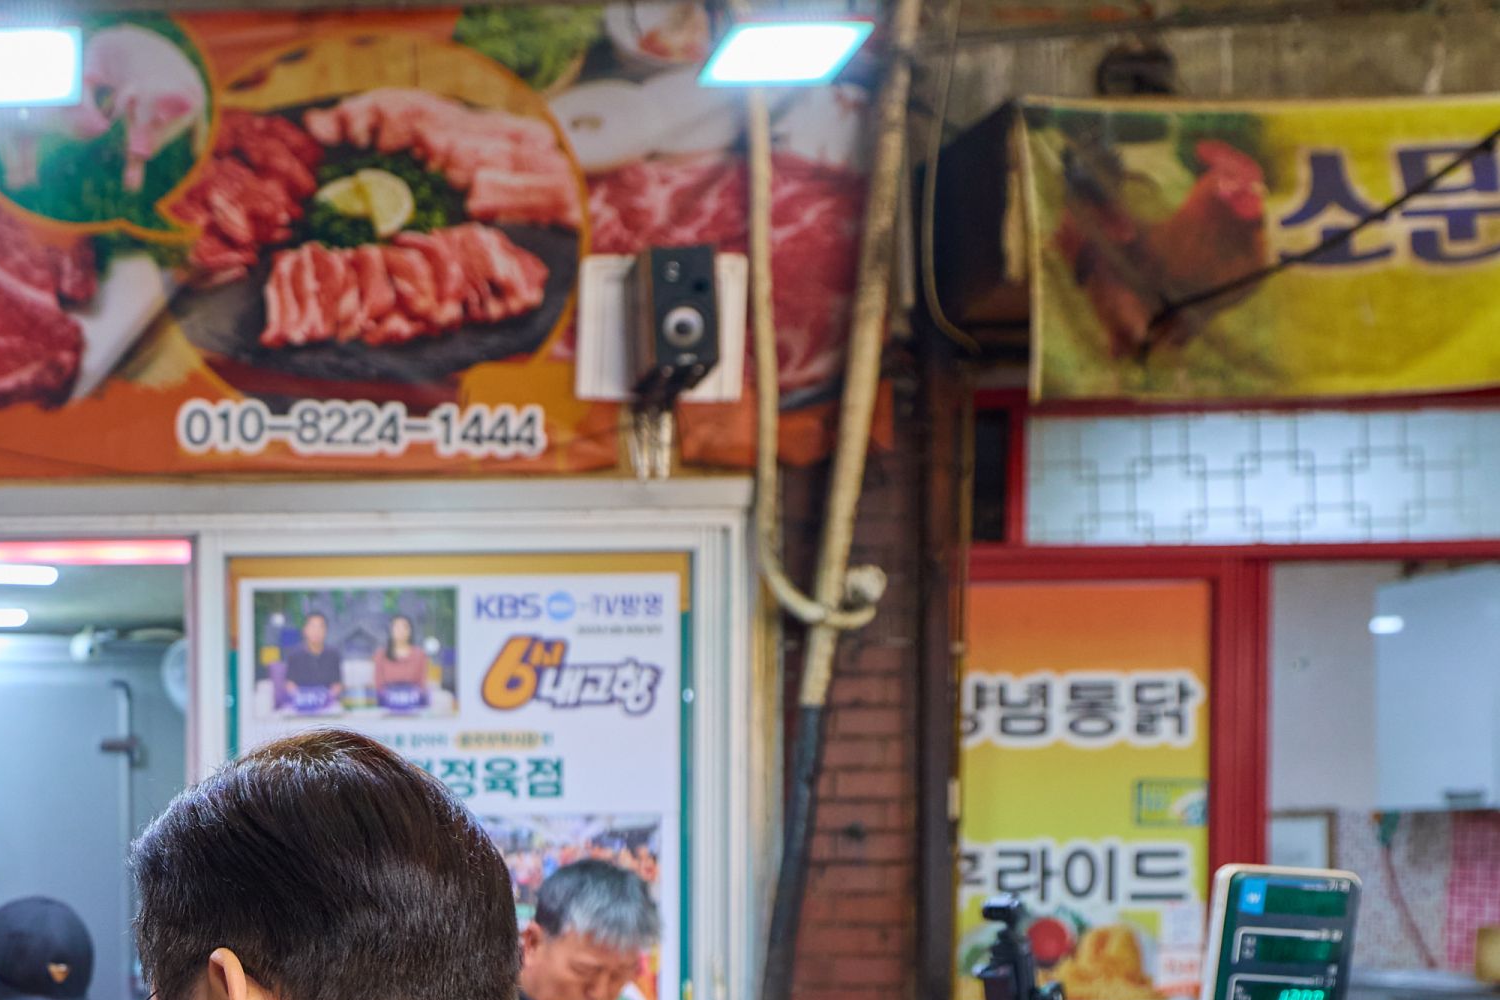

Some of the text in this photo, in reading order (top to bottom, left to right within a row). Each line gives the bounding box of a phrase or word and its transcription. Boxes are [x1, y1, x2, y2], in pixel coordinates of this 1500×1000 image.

[182, 403, 545, 454] 010-8224-1444
[474, 593, 542, 620] KBS
[420, 756, 565, 800] 정육점
